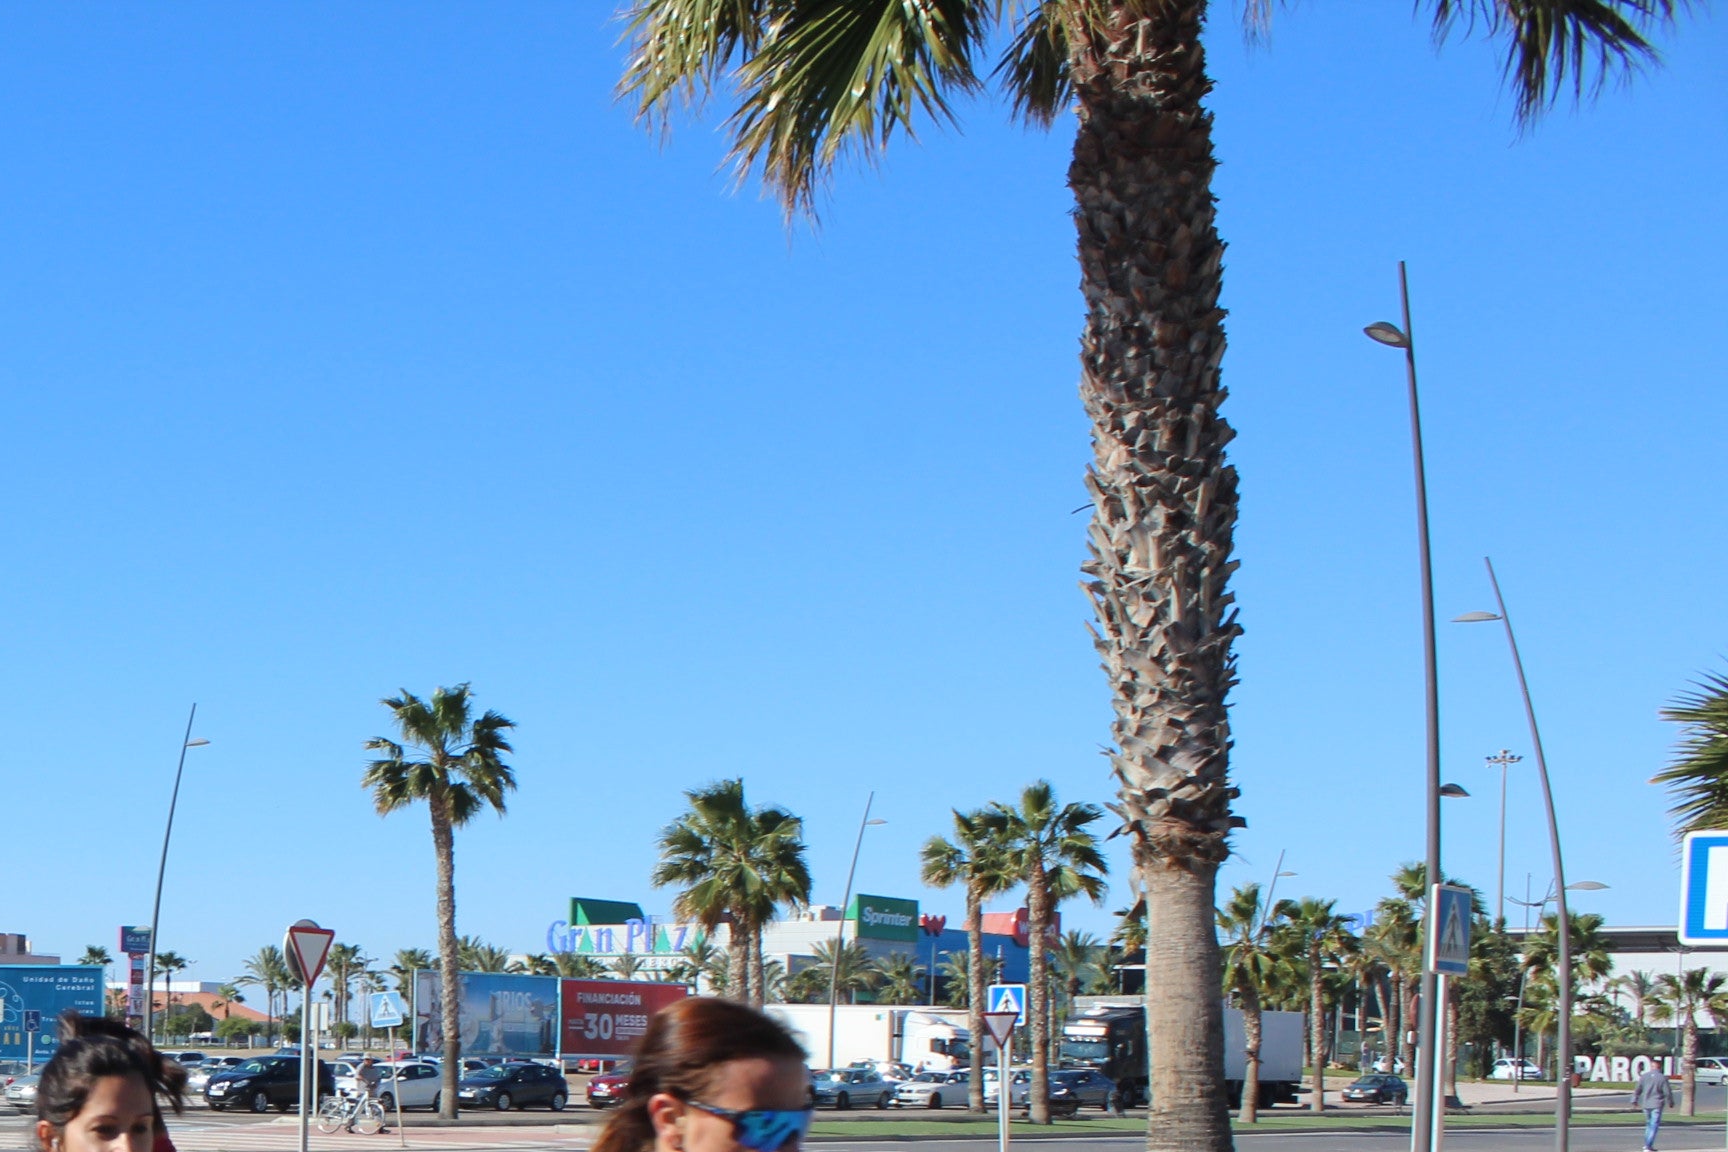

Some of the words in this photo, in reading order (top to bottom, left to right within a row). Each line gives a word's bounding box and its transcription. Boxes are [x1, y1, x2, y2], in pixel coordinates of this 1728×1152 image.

[861, 905, 913, 927] Sprinter
[576, 989, 642, 1006] FINANCIACIÓN
[584, 1012, 614, 1041] 30
[615, 1014, 648, 1027] MESES
